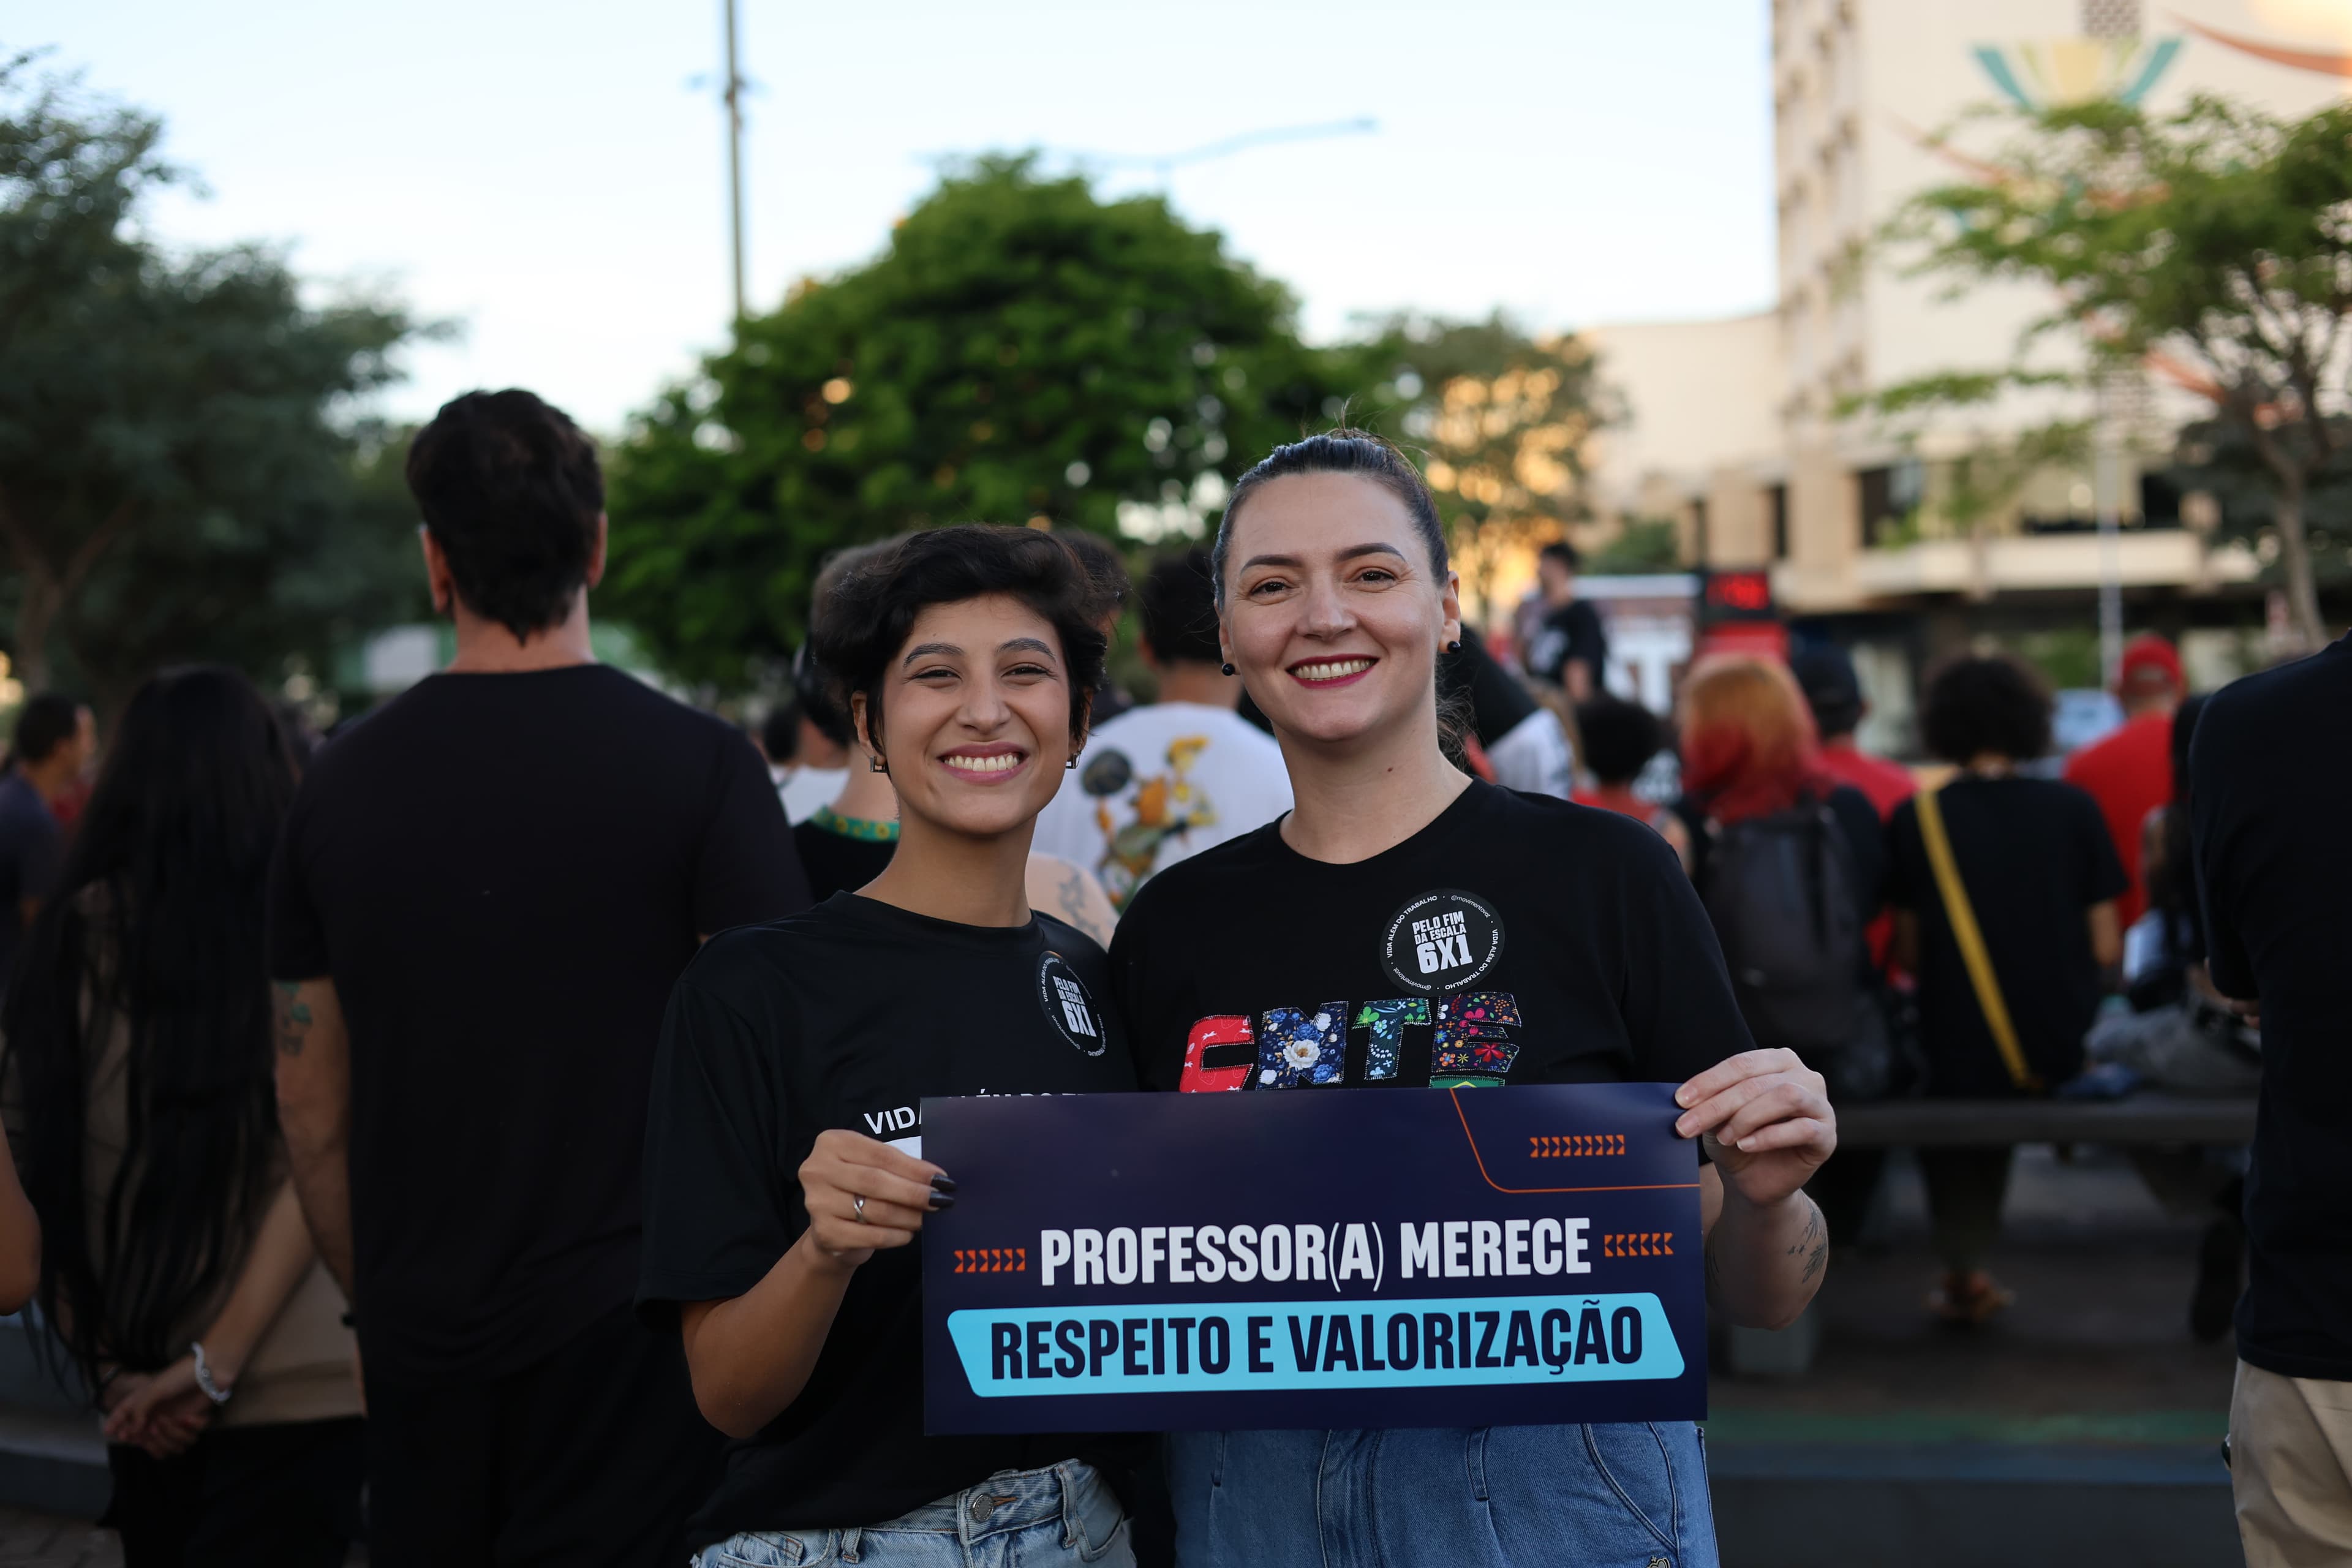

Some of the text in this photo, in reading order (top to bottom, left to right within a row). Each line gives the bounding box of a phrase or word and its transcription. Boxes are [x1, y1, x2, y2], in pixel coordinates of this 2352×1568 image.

[1388, 924, 1399, 941] ALÉM
[1396, 914, 1405, 924] DO
[1403, 895, 1438, 915] TRABALHO
[1451, 895, 1491, 918] @movimentovat
[1412, 911, 1465, 935] PELO FIM
[1414, 923, 1467, 945] DA ESCALA
[1417, 934, 1473, 974] 6X1
[1479, 962, 1488, 971] DO
[1485, 946, 1497, 963] ALÉM
[1444, 971, 1480, 990] TRABALHO
[1061, 1000, 1097, 1037] 6X1
[864, 1106, 921, 1134] VID
[1041, 1217, 1591, 1292] PROFESSOR(A) MERECE
[991, 1300, 1643, 1380] RESPEITO E VALORIZAÇÃO
